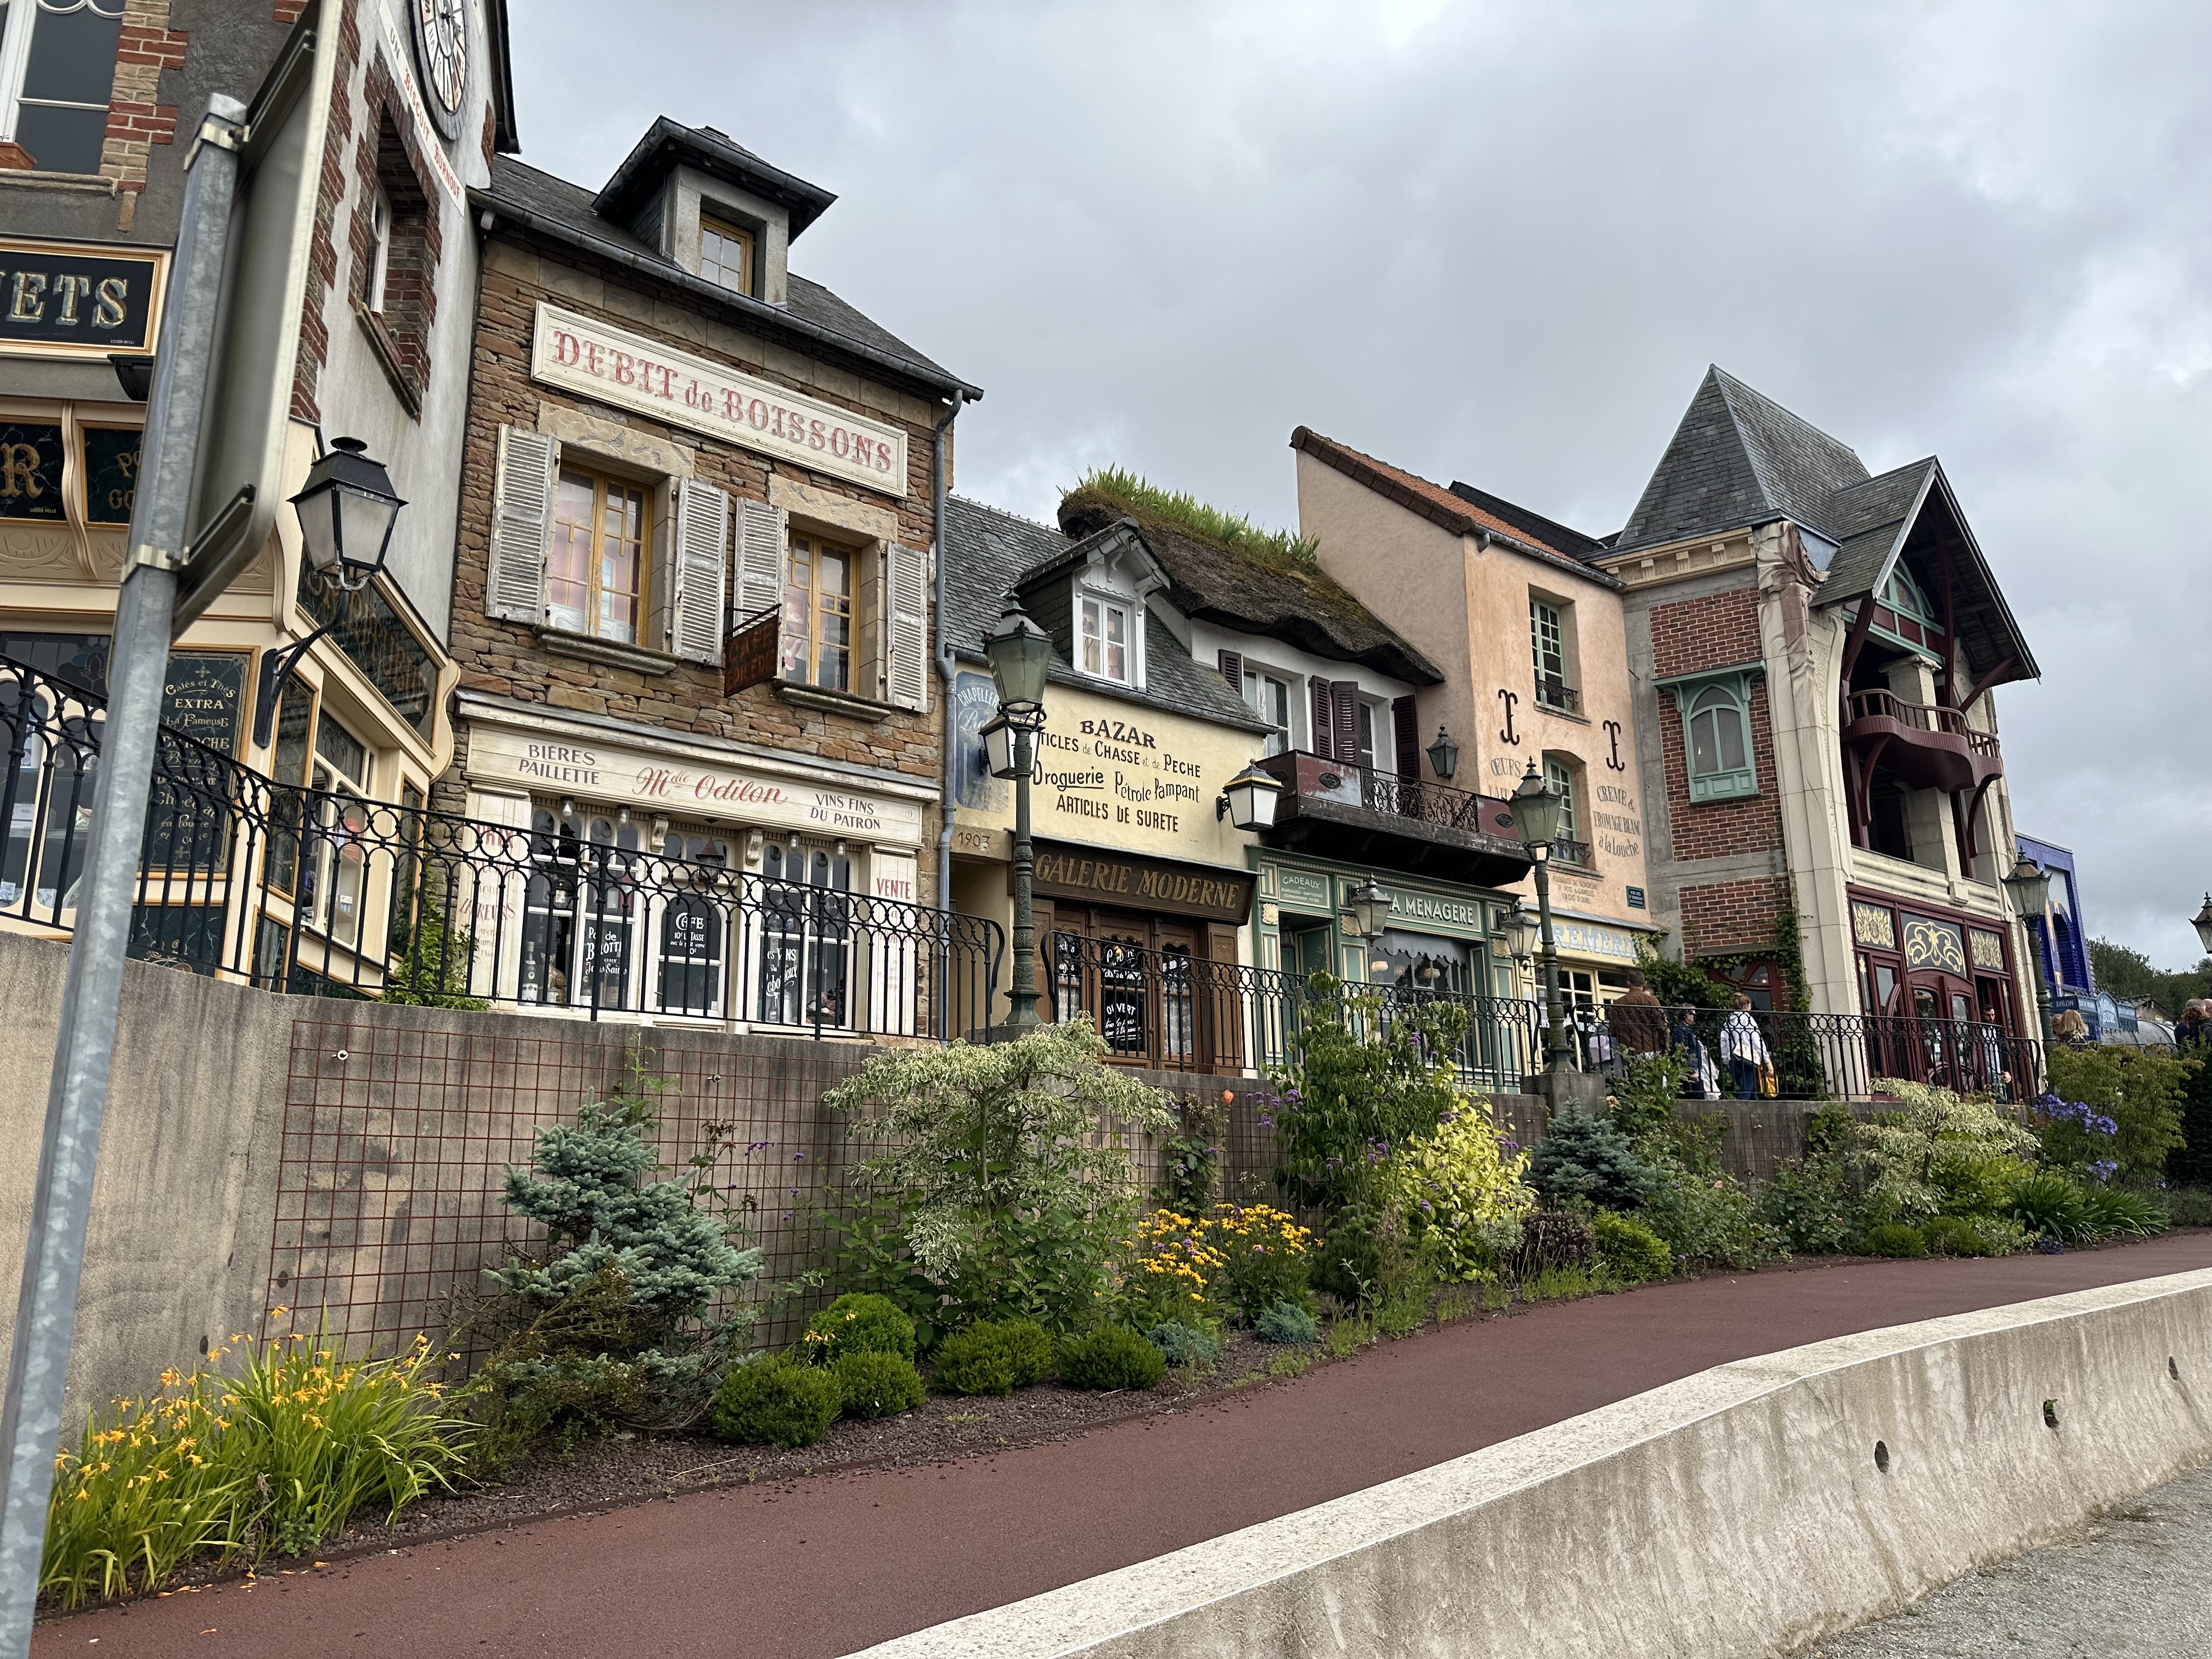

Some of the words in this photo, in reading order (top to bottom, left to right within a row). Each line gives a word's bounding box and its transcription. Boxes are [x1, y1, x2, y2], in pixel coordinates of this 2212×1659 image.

[390, 27, 400, 60] UN
[404, 67, 430, 142] BISCUIT
[434, 143, 460, 200] BURNOUF
[0, 270, 129, 329] ETS
[552, 330, 678, 400] DEBIT
[684, 379, 713, 413] de
[720, 387, 892, 473] BOISSONS
[174, 698, 224, 709] EXTRA
[1080, 719, 1156, 749] BAZAR
[1040, 731, 1079, 752] TICLES
[1082, 743, 1092, 755] de
[1094, 740, 1140, 765] CHASSE
[1142, 755, 1149, 768] et
[1152, 758, 1160, 770] de
[1163, 753, 1200, 778] PECHE
[1490, 757, 1521, 778] ŒUFS
[518, 759, 600, 785] PAILLETTE
[1033, 760, 1104, 792] Droguerie
[1114, 771, 1152, 802] Pétrole
[695, 774, 789, 804] Odilon
[1596, 785, 1627, 806] CREME
[1628, 798, 1635, 812] &
[815, 793, 844, 808] VINS
[848, 798, 874, 815] FINS
[1056, 794, 1108, 820] ARTICLES
[1136, 809, 1178, 833] SURETE
[810, 806, 828, 822] DU
[834, 813, 881, 830] PATRON
[1593, 810, 1623, 832] FROMAGE
[1622, 816, 1641, 837] BLANC
[1604, 833, 1611, 853] la
[1612, 837, 1640, 857] Louche
[876, 877, 911, 900] VENTE
[1035, 854, 1132, 895] GALERIE
[1135, 868, 1240, 910] MODERNE
[1282, 876, 1320, 890] CADEAUX
[1385, 893, 1401, 912] A
[1404, 895, 1474, 924] MENAGERE
[605, 930, 617, 941] de
[690, 932, 704, 941] TASSE
[767, 950, 775, 960] es
[776, 947, 797, 961] VNS
[2056, 999, 2074, 1008] SALON
